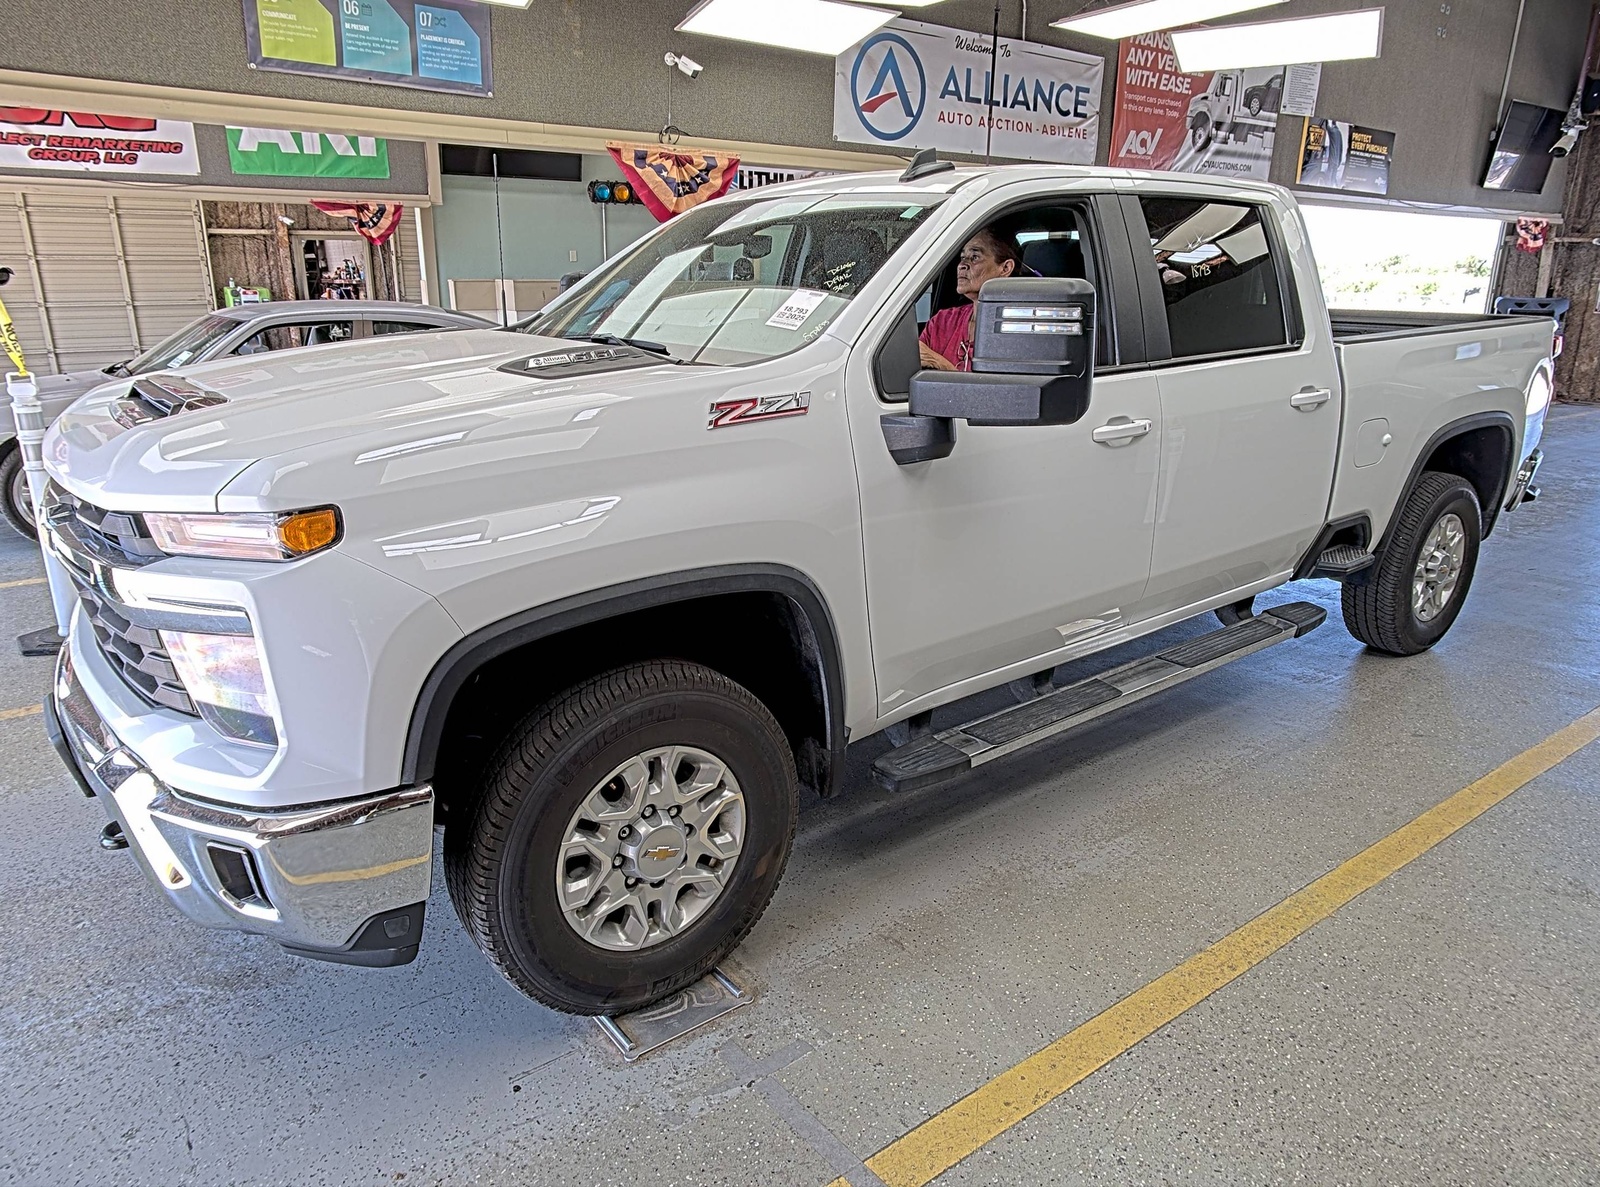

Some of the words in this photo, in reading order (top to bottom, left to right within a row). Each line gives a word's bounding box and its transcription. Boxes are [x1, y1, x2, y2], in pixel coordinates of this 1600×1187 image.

[343, 0, 359, 16] 06
[420, 12, 432, 26] 07
[351, 23, 370, 32] PRESENT
[420, 34, 443, 42] PLACEMENT
[448, 38, 466, 46] CRITICAL
[1000, 44, 1011, 58] To
[1126, 47, 1156, 68] ANY
[1126, 67, 1159, 88] WITH
[1159, 74, 1192, 94] EASE.
[939, 65, 1090, 118] ALLIANCE
[1124, 91, 1146, 103] Transport
[1157, 96, 1182, 107] purchased
[1144, 106, 1152, 114] any
[1153, 106, 1164, 114] lane.
[1166, 109, 1180, 118] Today.
[938, 111, 972, 126] AUTO
[978, 116, 1032, 134] AUCTION
[1042, 124, 1088, 140] ABILENE
[0, 132, 45, 146] LECT
[47, 136, 183, 154] REMARKETING
[1118, 128, 1163, 158] ACV
[1352, 132, 1372, 143] PROTECT
[1351, 141, 1366, 151] EVERY
[28, 148, 100, 164] GROUP,
[104, 152, 138, 164] LLC
[707, 390, 811, 430] Z71
